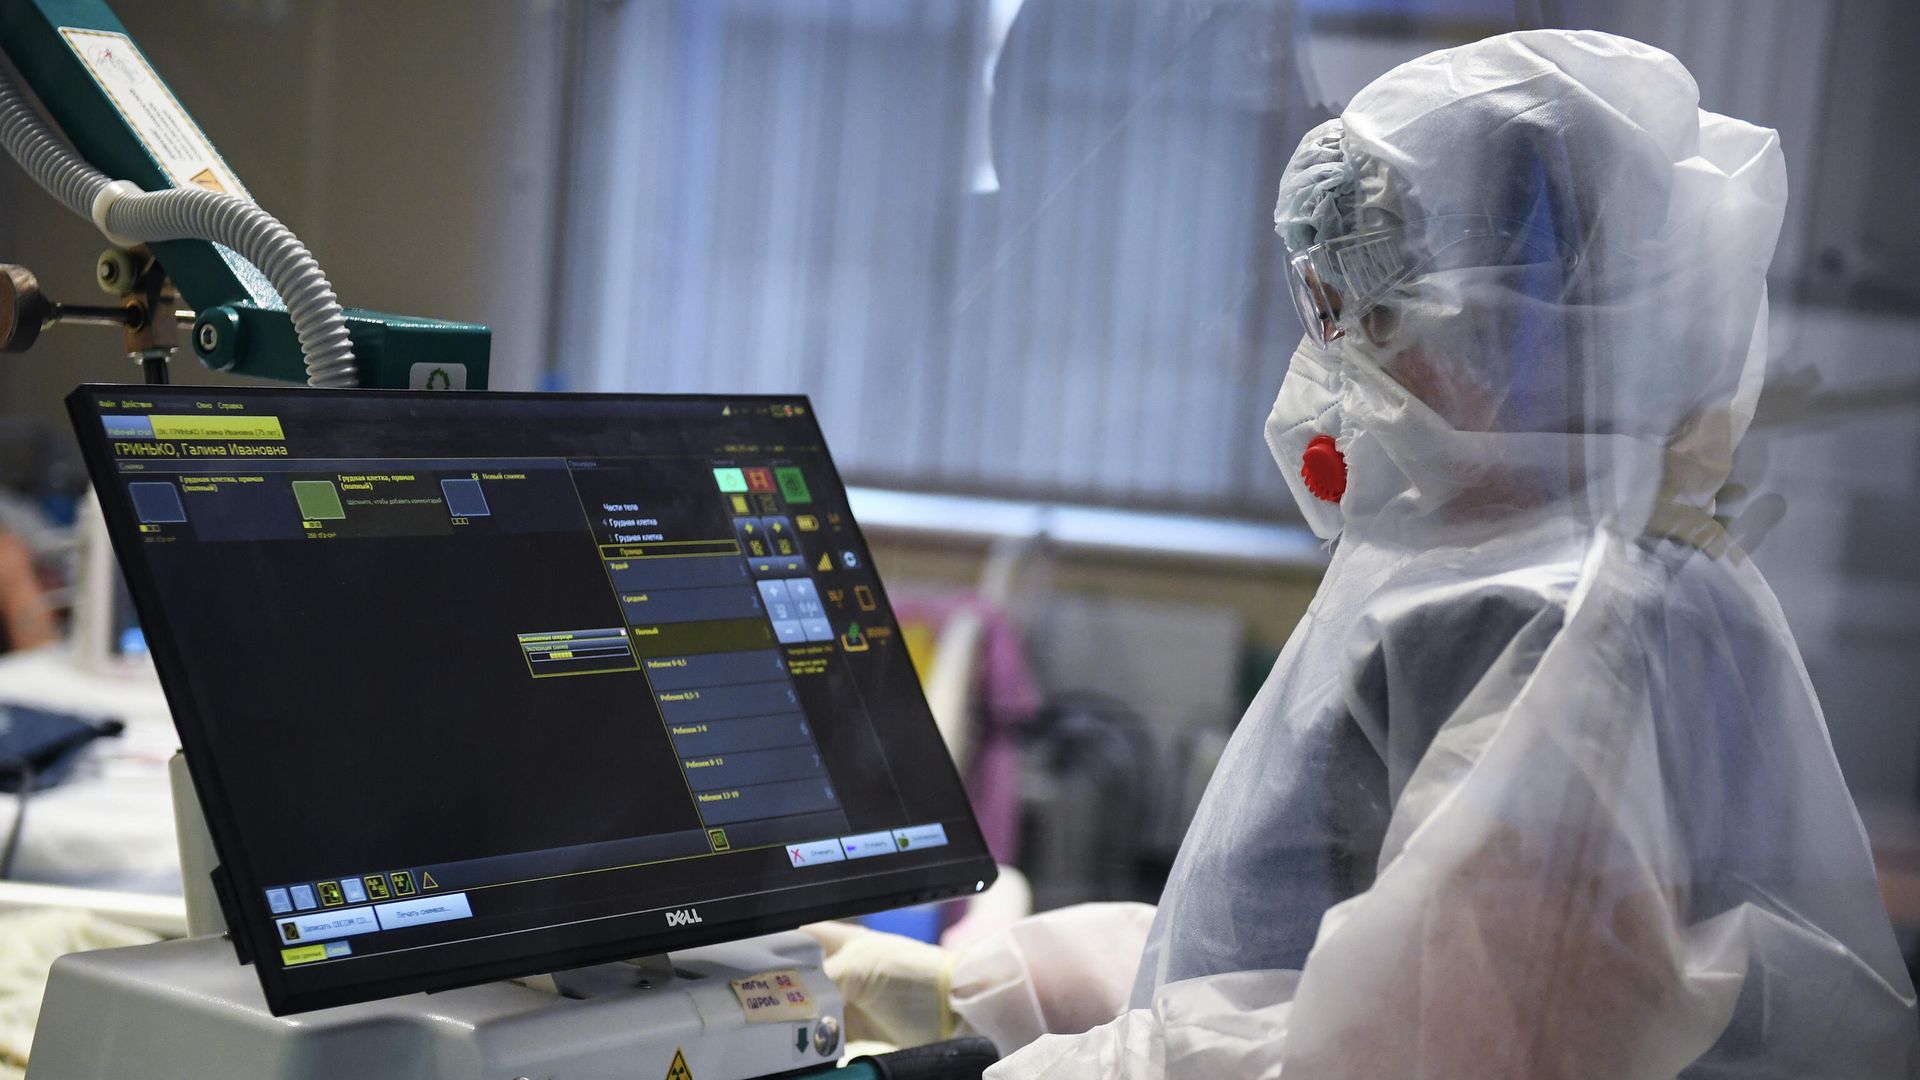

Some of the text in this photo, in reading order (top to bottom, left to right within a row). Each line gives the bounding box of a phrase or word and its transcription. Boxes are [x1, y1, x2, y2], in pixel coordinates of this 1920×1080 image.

[217, 402, 244, 410] Справка
[114, 442, 288, 458] ГРИНЬКО, Галина Ивановна
[603, 503, 623, 512] Части
[665, 908, 703, 927] DELL
